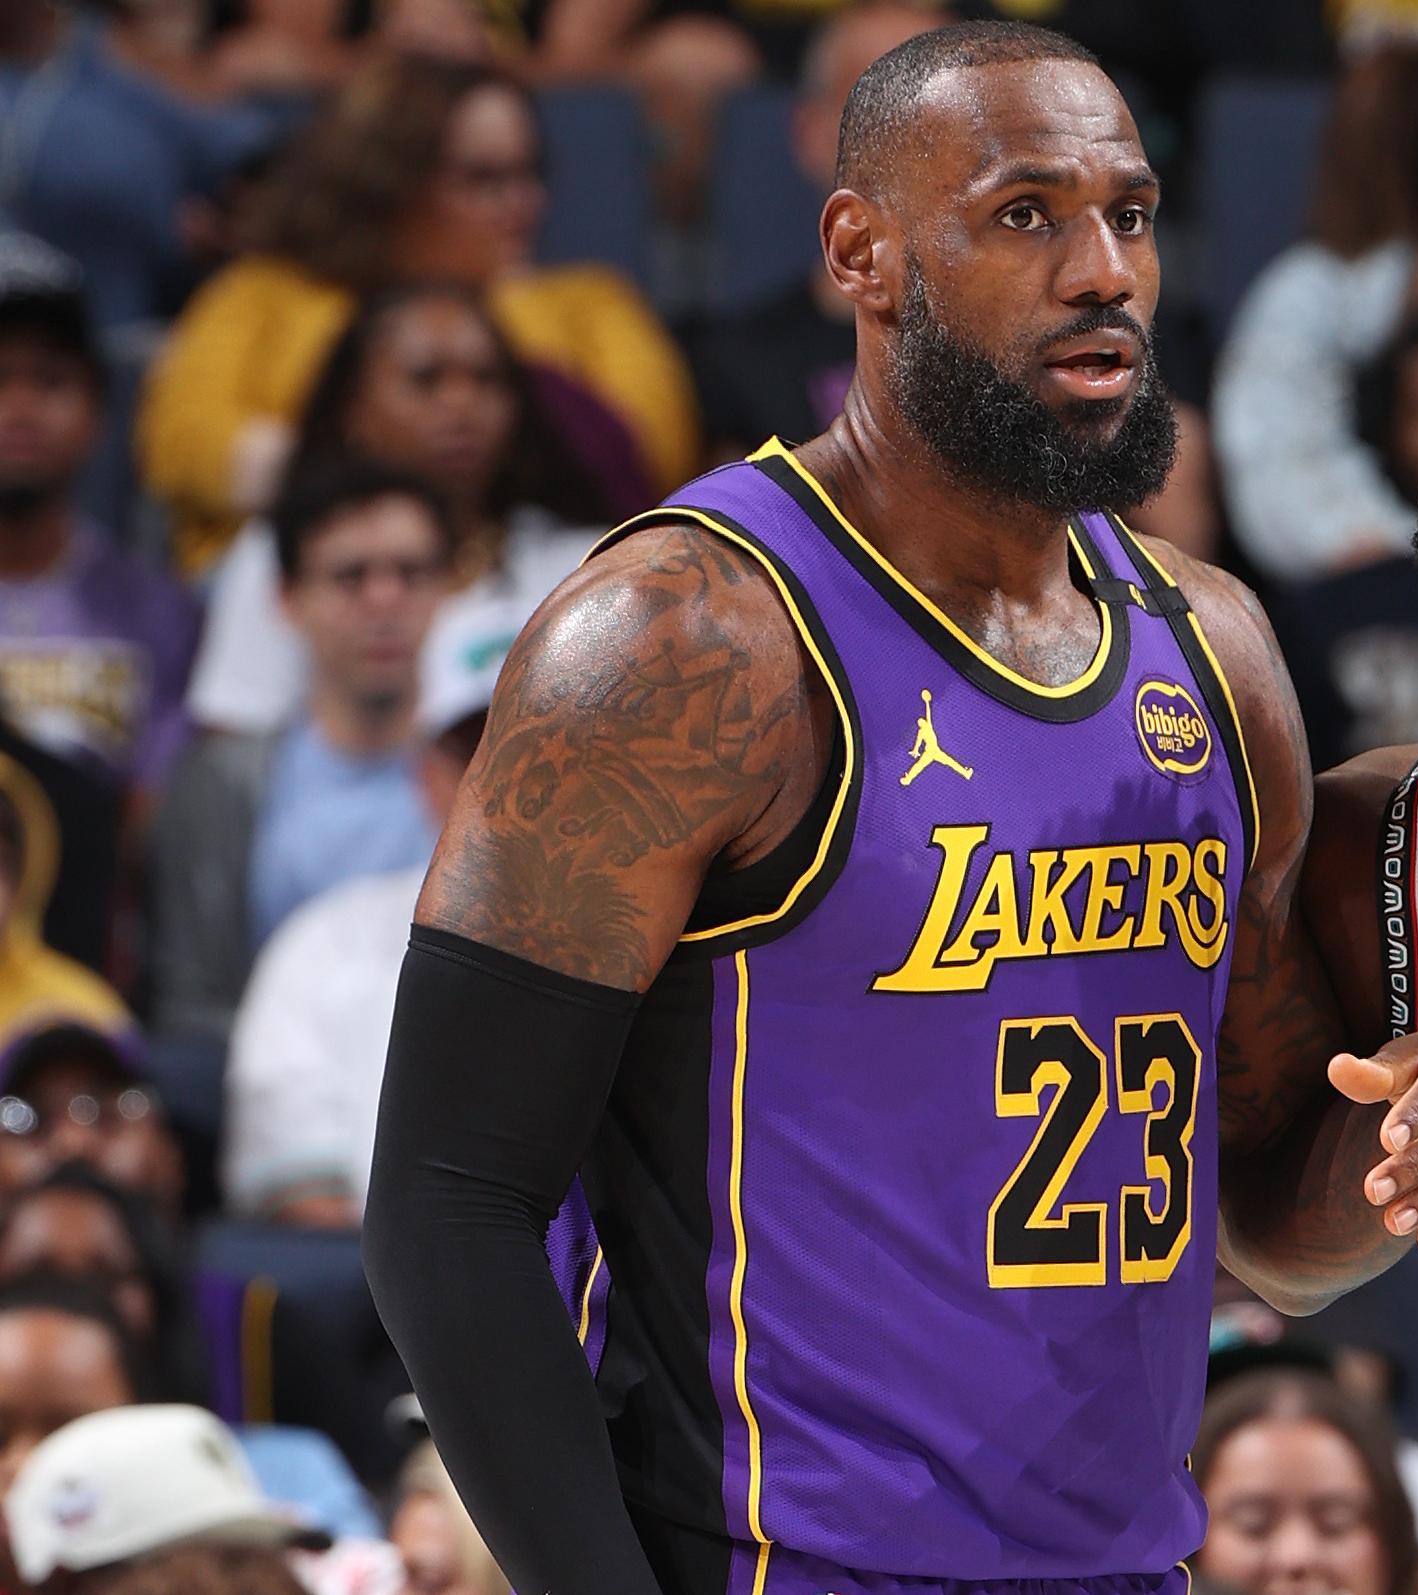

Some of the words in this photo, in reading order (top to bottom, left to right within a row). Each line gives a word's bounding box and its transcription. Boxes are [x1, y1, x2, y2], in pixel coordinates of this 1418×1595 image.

[1141, 703, 1204, 748] bibigo
[1156, 735, 1185, 753] 비비고
[868, 824, 1229, 993] LAKERS
[987, 1013, 1202, 1289] 23
